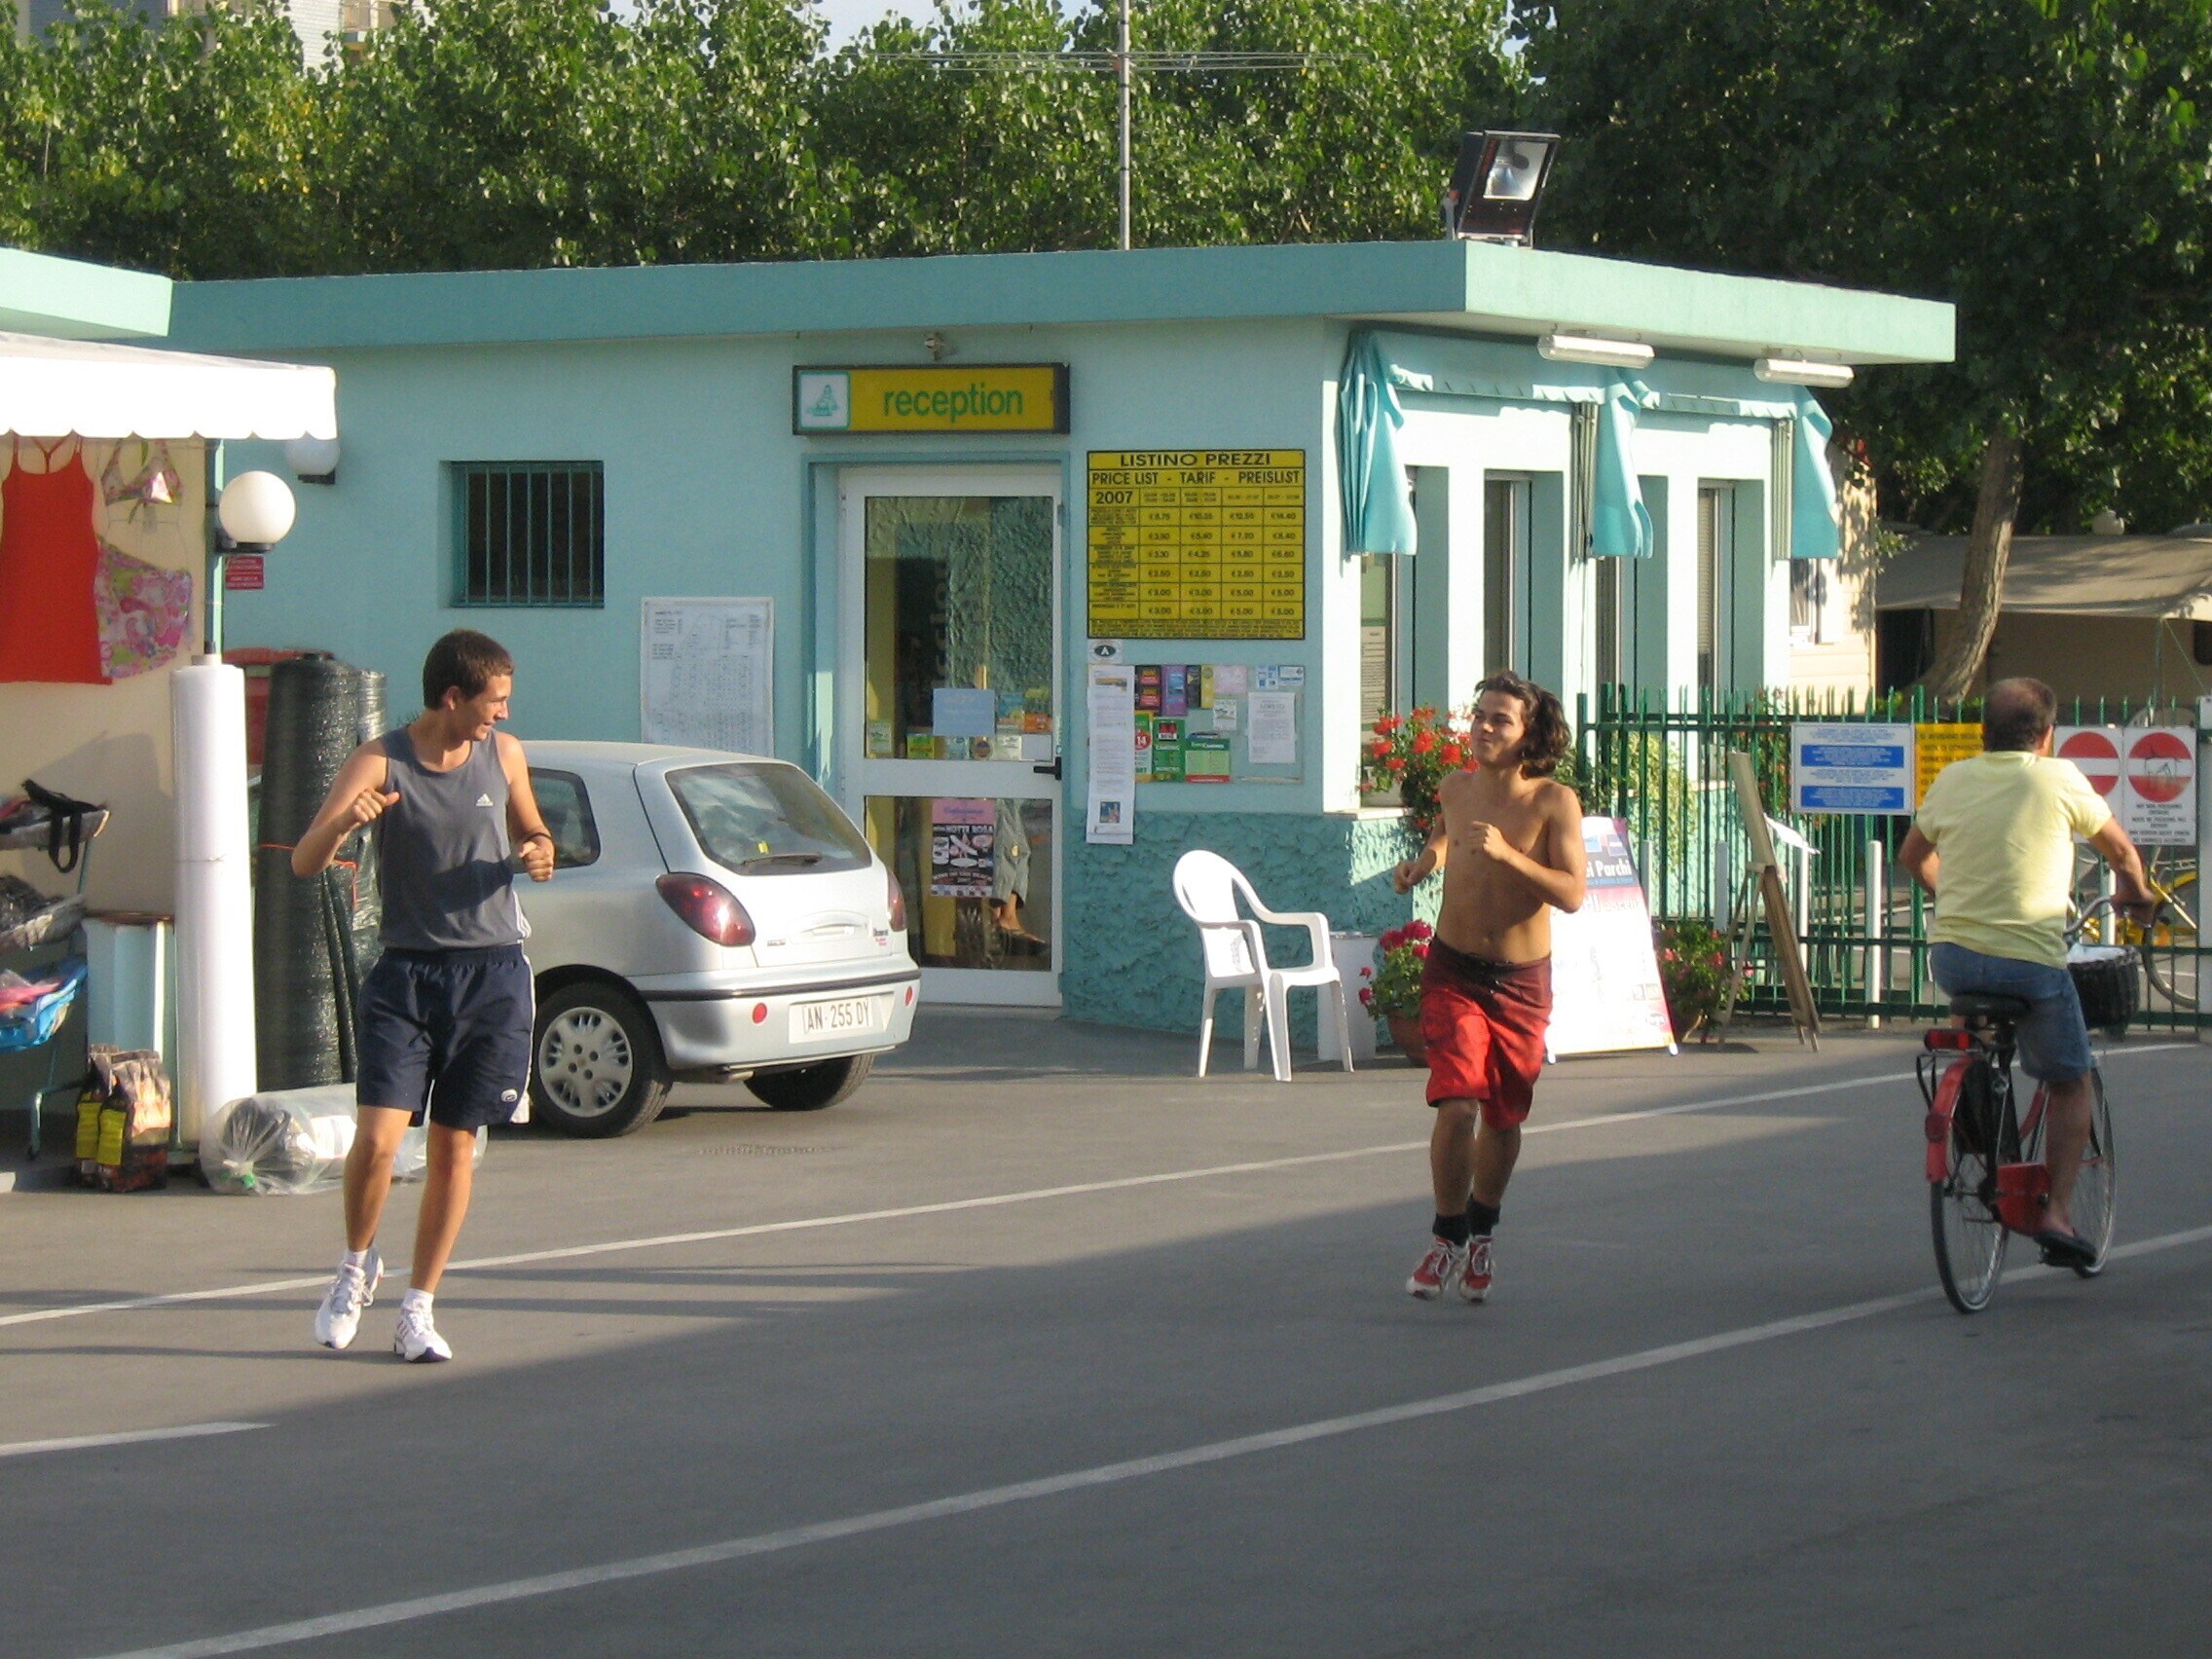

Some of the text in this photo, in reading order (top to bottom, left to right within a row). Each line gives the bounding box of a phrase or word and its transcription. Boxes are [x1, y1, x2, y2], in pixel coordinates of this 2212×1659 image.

[884, 382, 1023, 423] reception
[1121, 452, 1272, 467] LISTINO PREZZI
[1091, 472, 1130, 486] PRICE
[1134, 471, 1159, 486] LIST
[1179, 471, 1215, 485] TARIF
[1237, 470, 1300, 485] PREISLIST
[1095, 491, 1134, 505] 2007
[1595, 858, 1633, 877] Parchi
[807, 1006, 824, 1030] AN
[830, 1002, 853, 1028] 255
